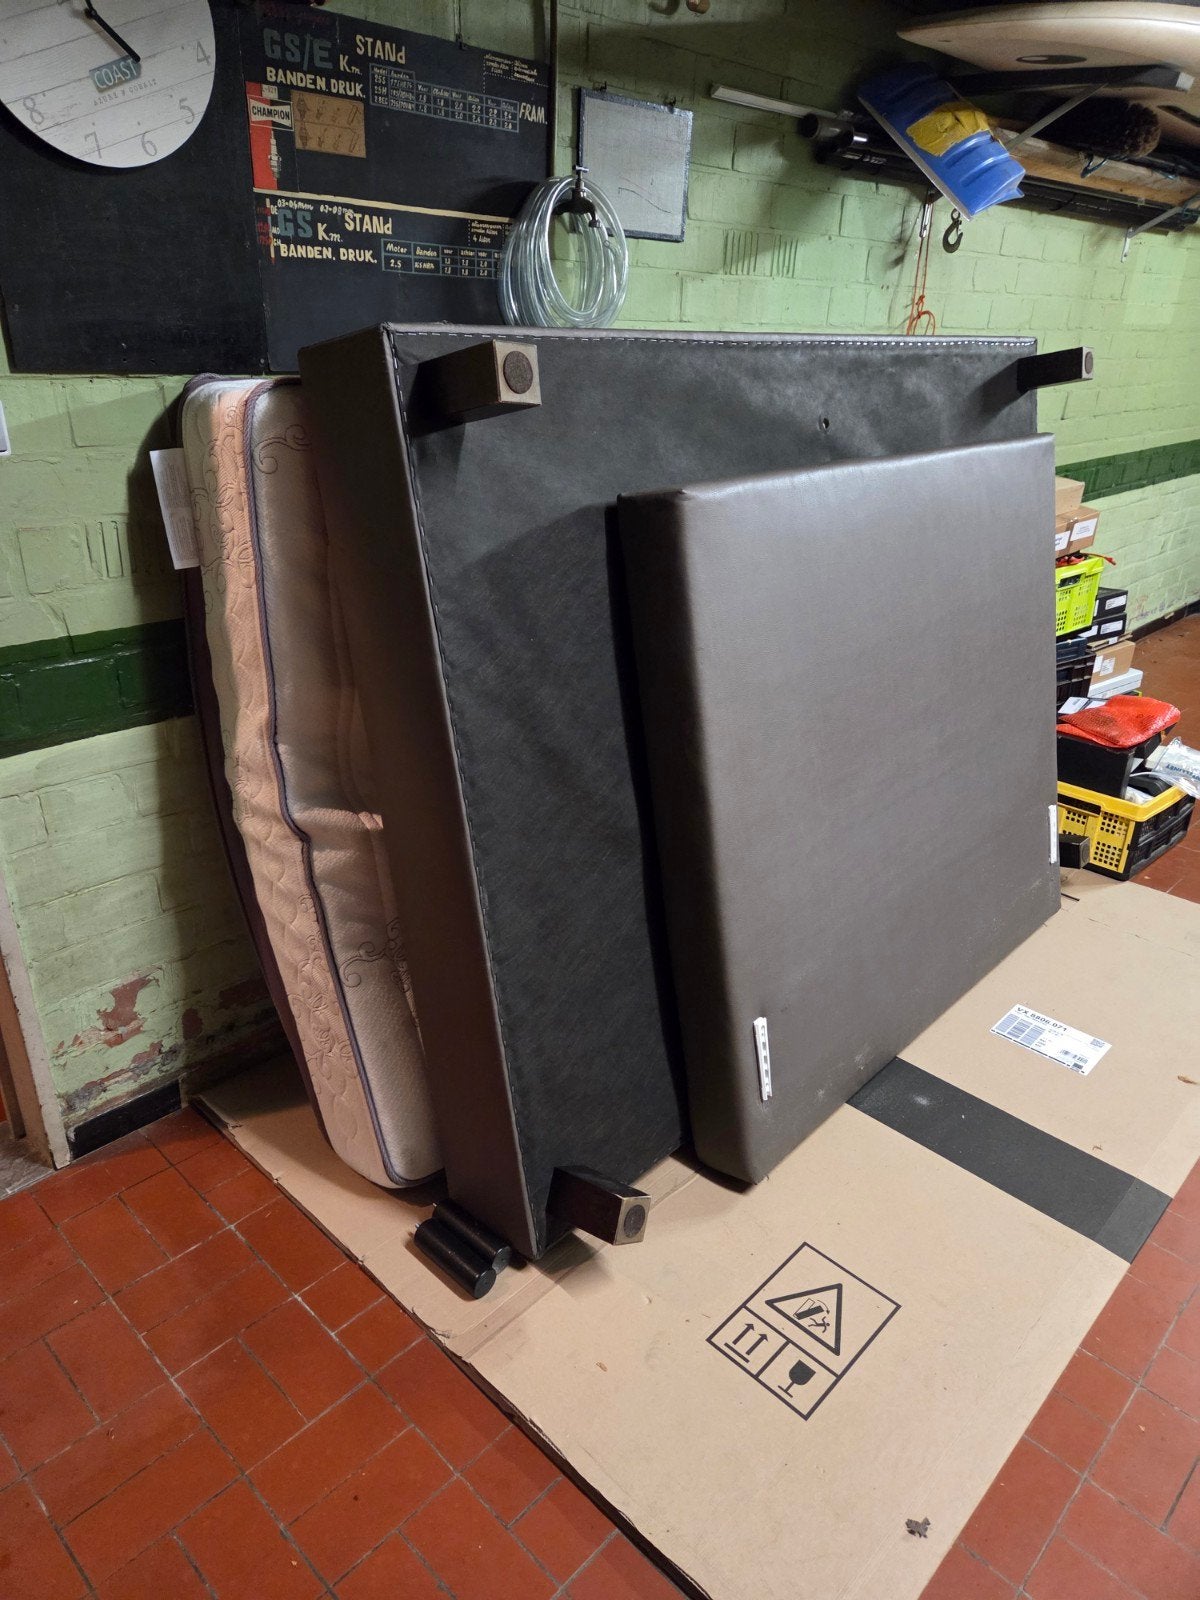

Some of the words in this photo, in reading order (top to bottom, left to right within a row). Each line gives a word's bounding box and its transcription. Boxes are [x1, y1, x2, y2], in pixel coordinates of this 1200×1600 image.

[196, 41, 211, 66] 4
[94, 59, 139, 89] COAST
[23, 97, 45, 126] 8
[178, 98, 196, 125] 5
[251, 105, 290, 121] CHAMPION
[84, 131, 103, 160] 7
[141, 132, 158, 158] 6
[277, 209, 313, 239] GS
